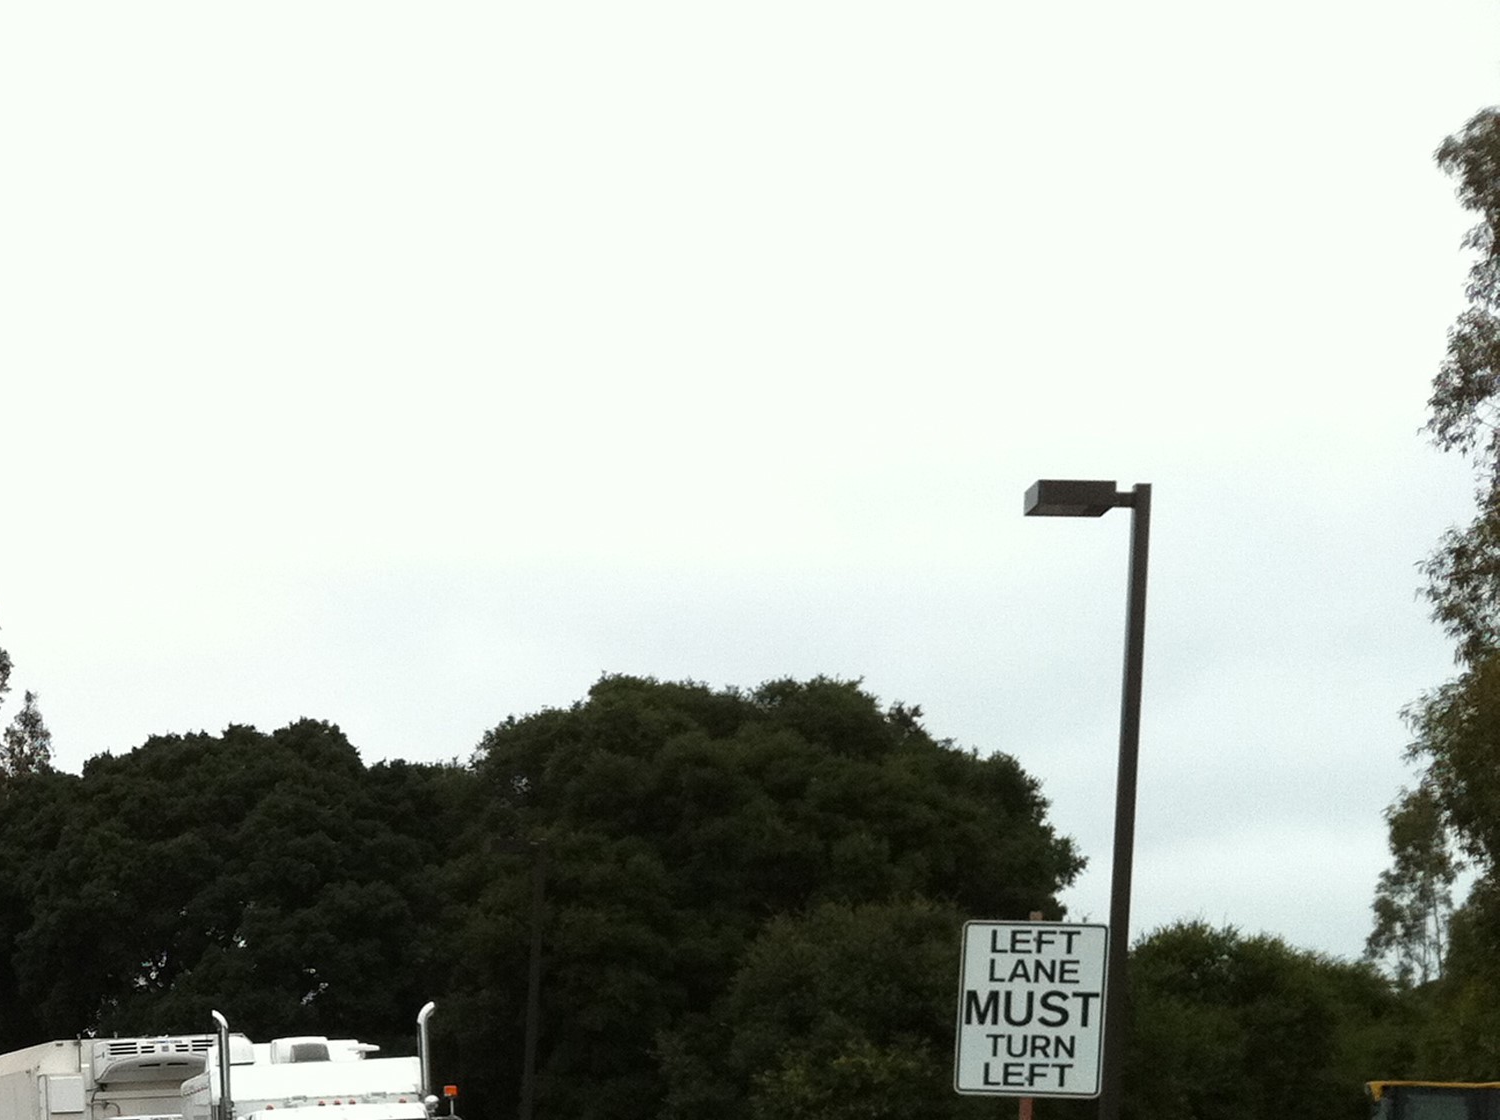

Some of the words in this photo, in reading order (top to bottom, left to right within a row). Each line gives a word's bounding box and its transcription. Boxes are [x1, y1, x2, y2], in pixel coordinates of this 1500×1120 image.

[990, 929, 1082, 955] LEFT
[988, 958, 1081, 984] LANE
[964, 989, 1100, 1028] MUST
[985, 1034, 1076, 1059] TURN
[982, 1062, 1074, 1088] LEFT
